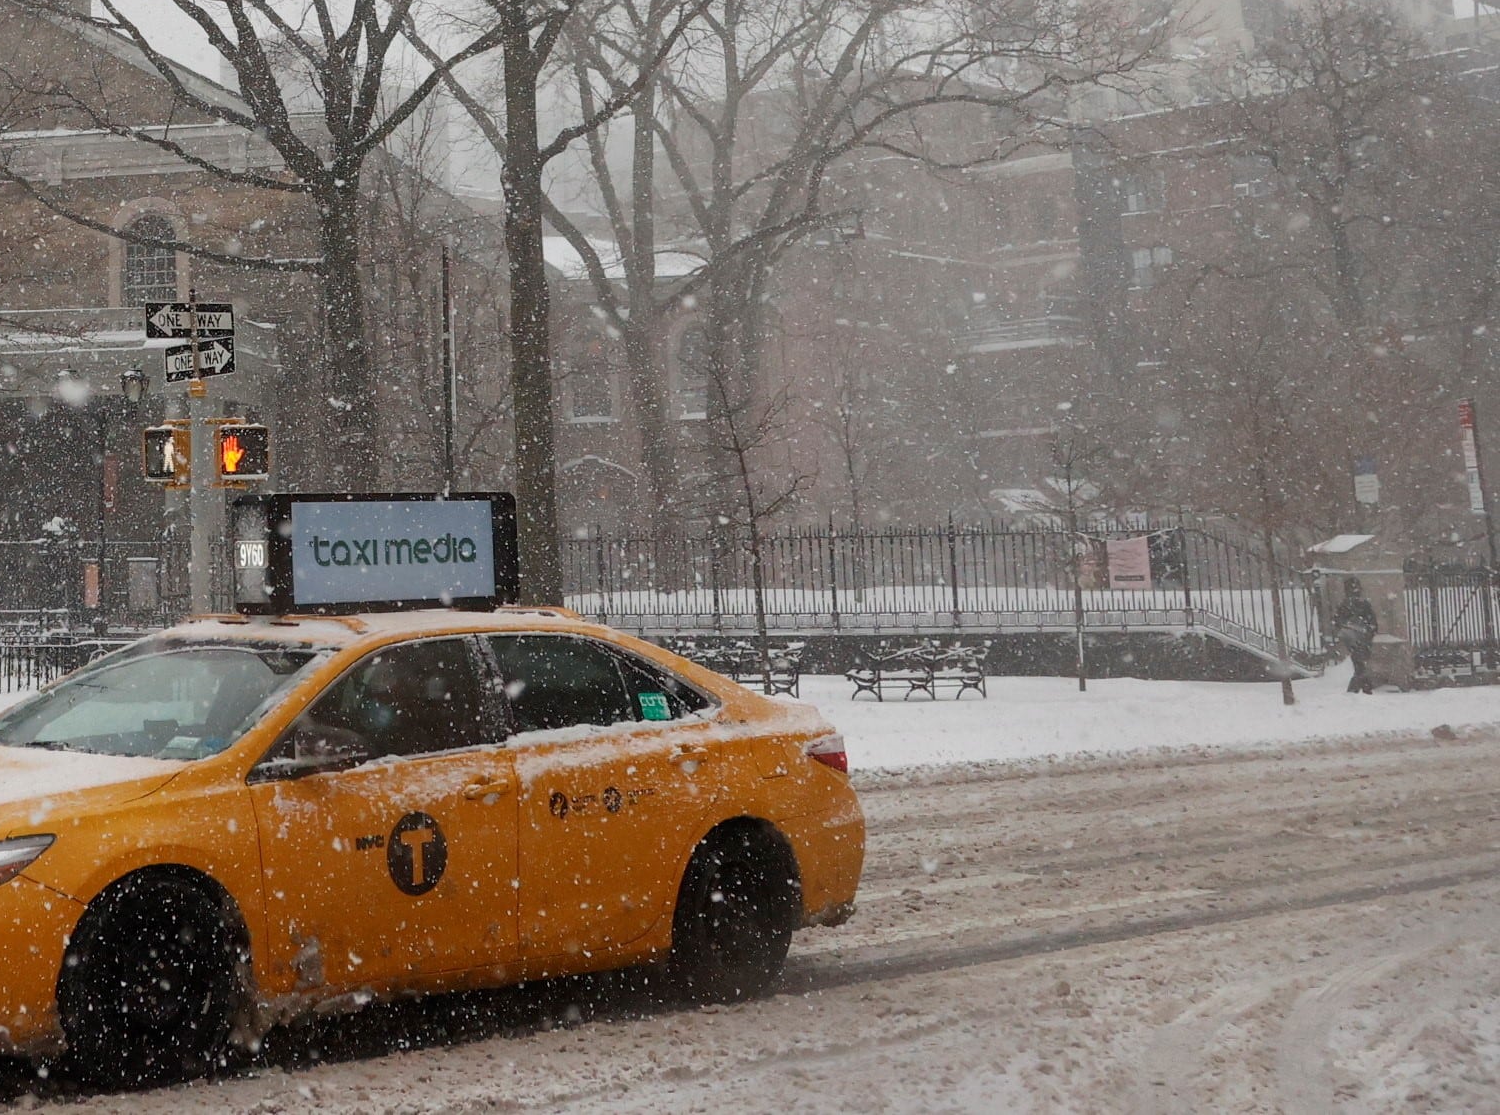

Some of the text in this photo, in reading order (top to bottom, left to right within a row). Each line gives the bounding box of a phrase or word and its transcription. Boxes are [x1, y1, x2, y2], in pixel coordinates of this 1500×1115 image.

[158, 313, 222, 328] ONE WAY
[174, 350, 225, 371] ONE WAY
[240, 544, 264, 566] 9Y60
[400, 828, 433, 886] T
